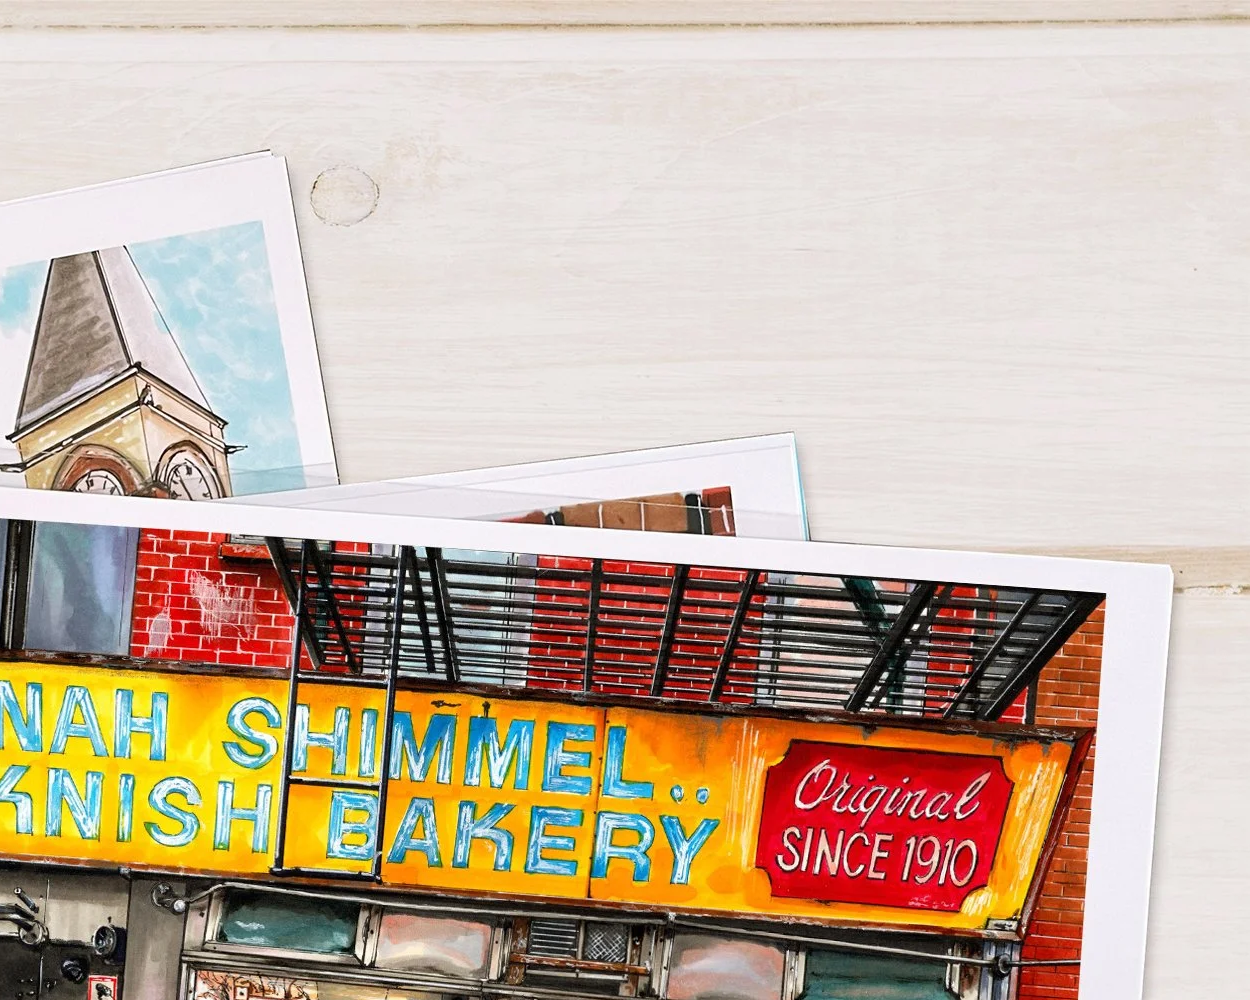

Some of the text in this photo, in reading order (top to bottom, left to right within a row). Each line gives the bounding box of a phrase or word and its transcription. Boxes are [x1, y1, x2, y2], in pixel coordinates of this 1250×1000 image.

[794, 758, 992, 829] Original
[326, 790, 720, 885] BAKERY
[775, 826, 978, 888] SINCE 1910
